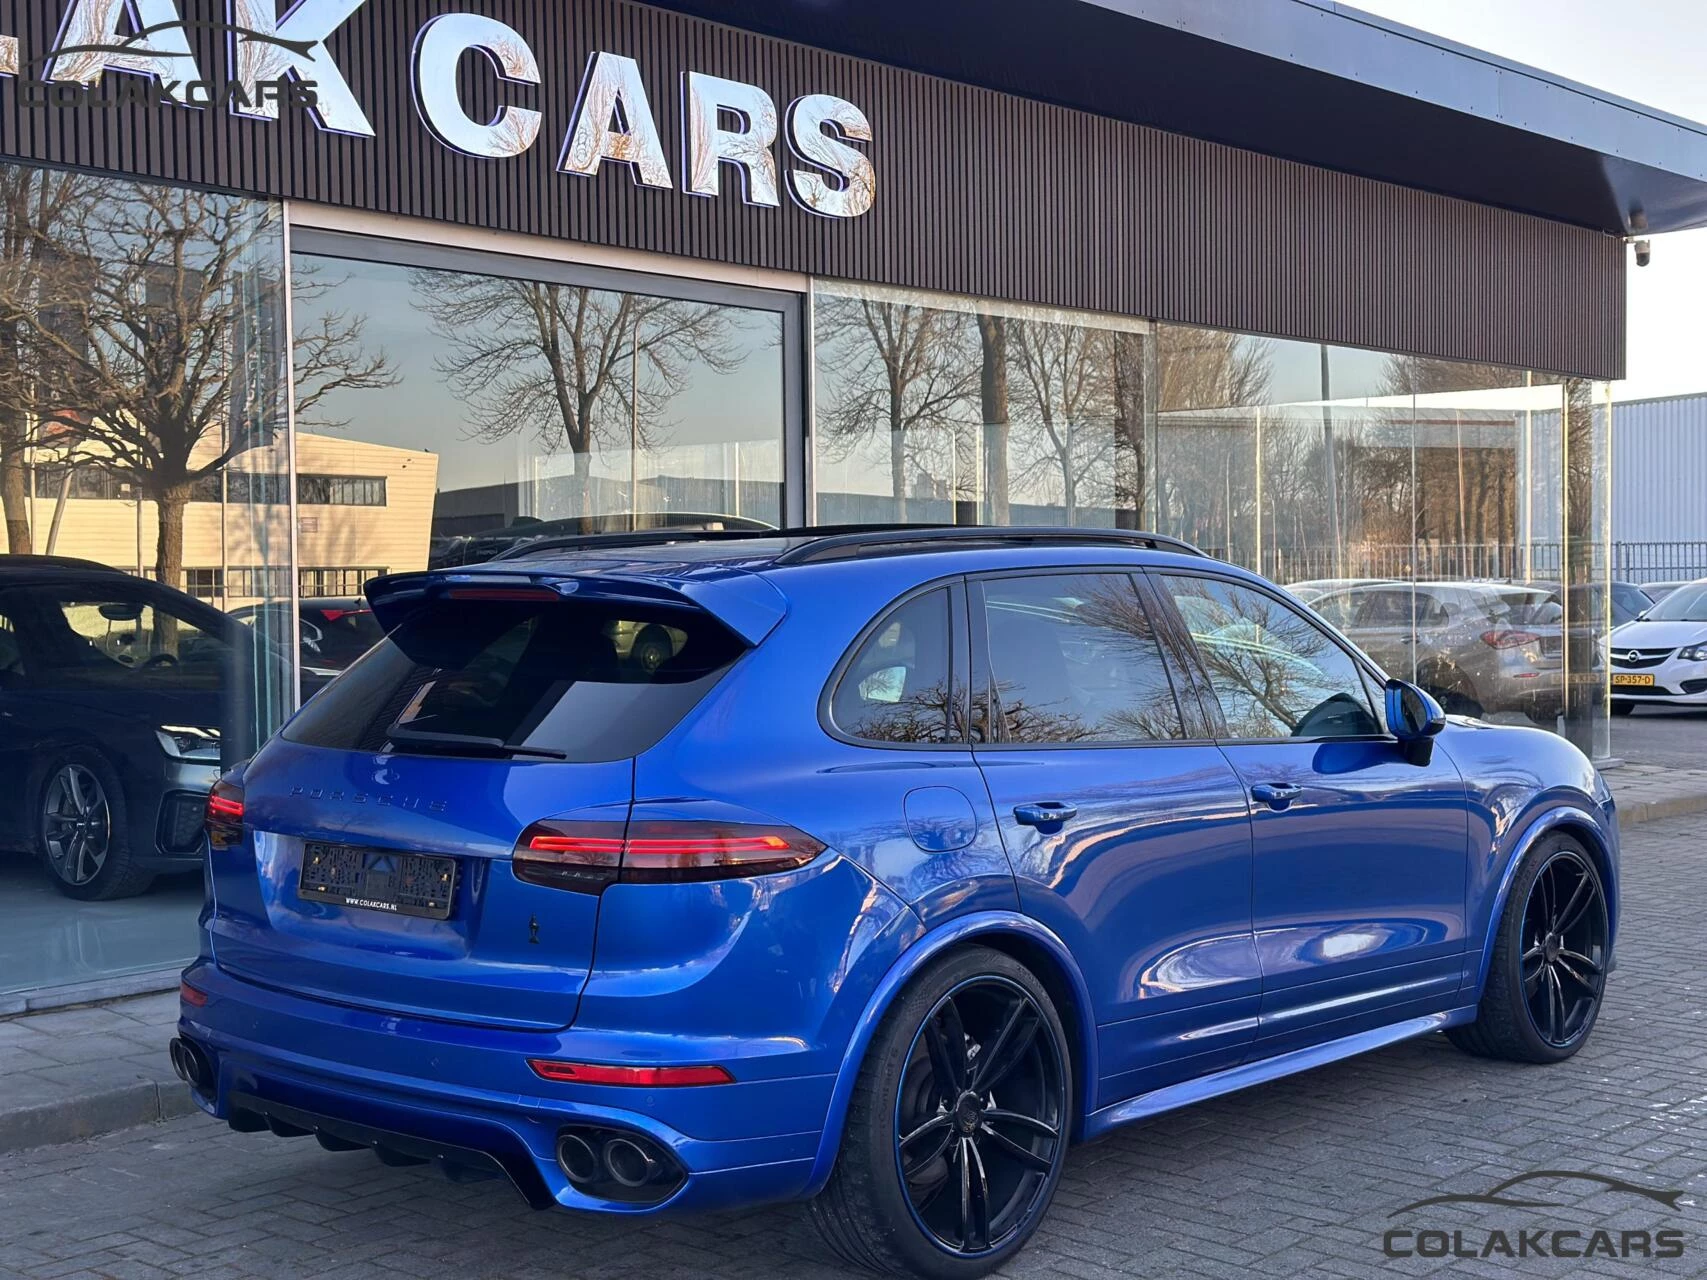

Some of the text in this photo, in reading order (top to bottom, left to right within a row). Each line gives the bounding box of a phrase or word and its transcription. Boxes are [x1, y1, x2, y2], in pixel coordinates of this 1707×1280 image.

[0, 0, 876, 219] AK CARS
[1615, 675, 1651, 685] SP-357-D
[289, 784, 448, 811] PORSCHE
[345, 896, 398, 911] WWW.COLAKCARS.NL
